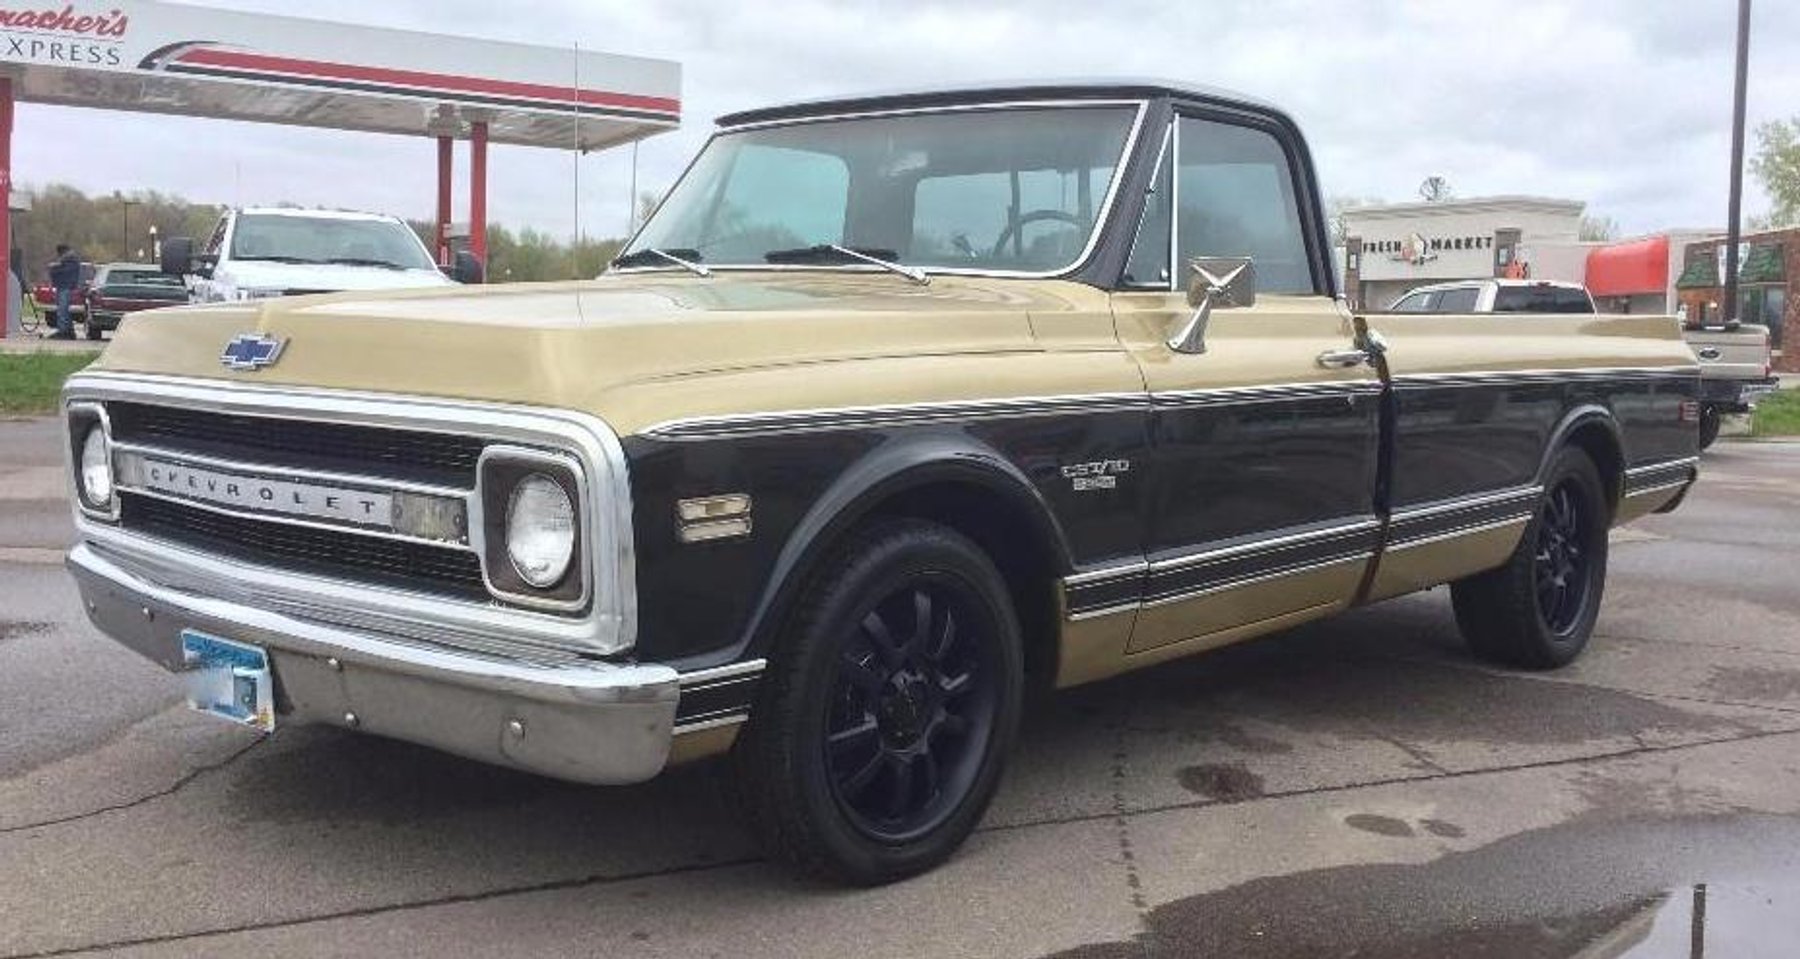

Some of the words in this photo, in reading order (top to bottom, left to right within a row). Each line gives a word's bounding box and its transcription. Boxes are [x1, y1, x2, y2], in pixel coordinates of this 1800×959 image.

[7, 36, 120, 65] XPRESS
[1363, 239, 1401, 253] FRESH
[1431, 236, 1493, 251] MARKET
